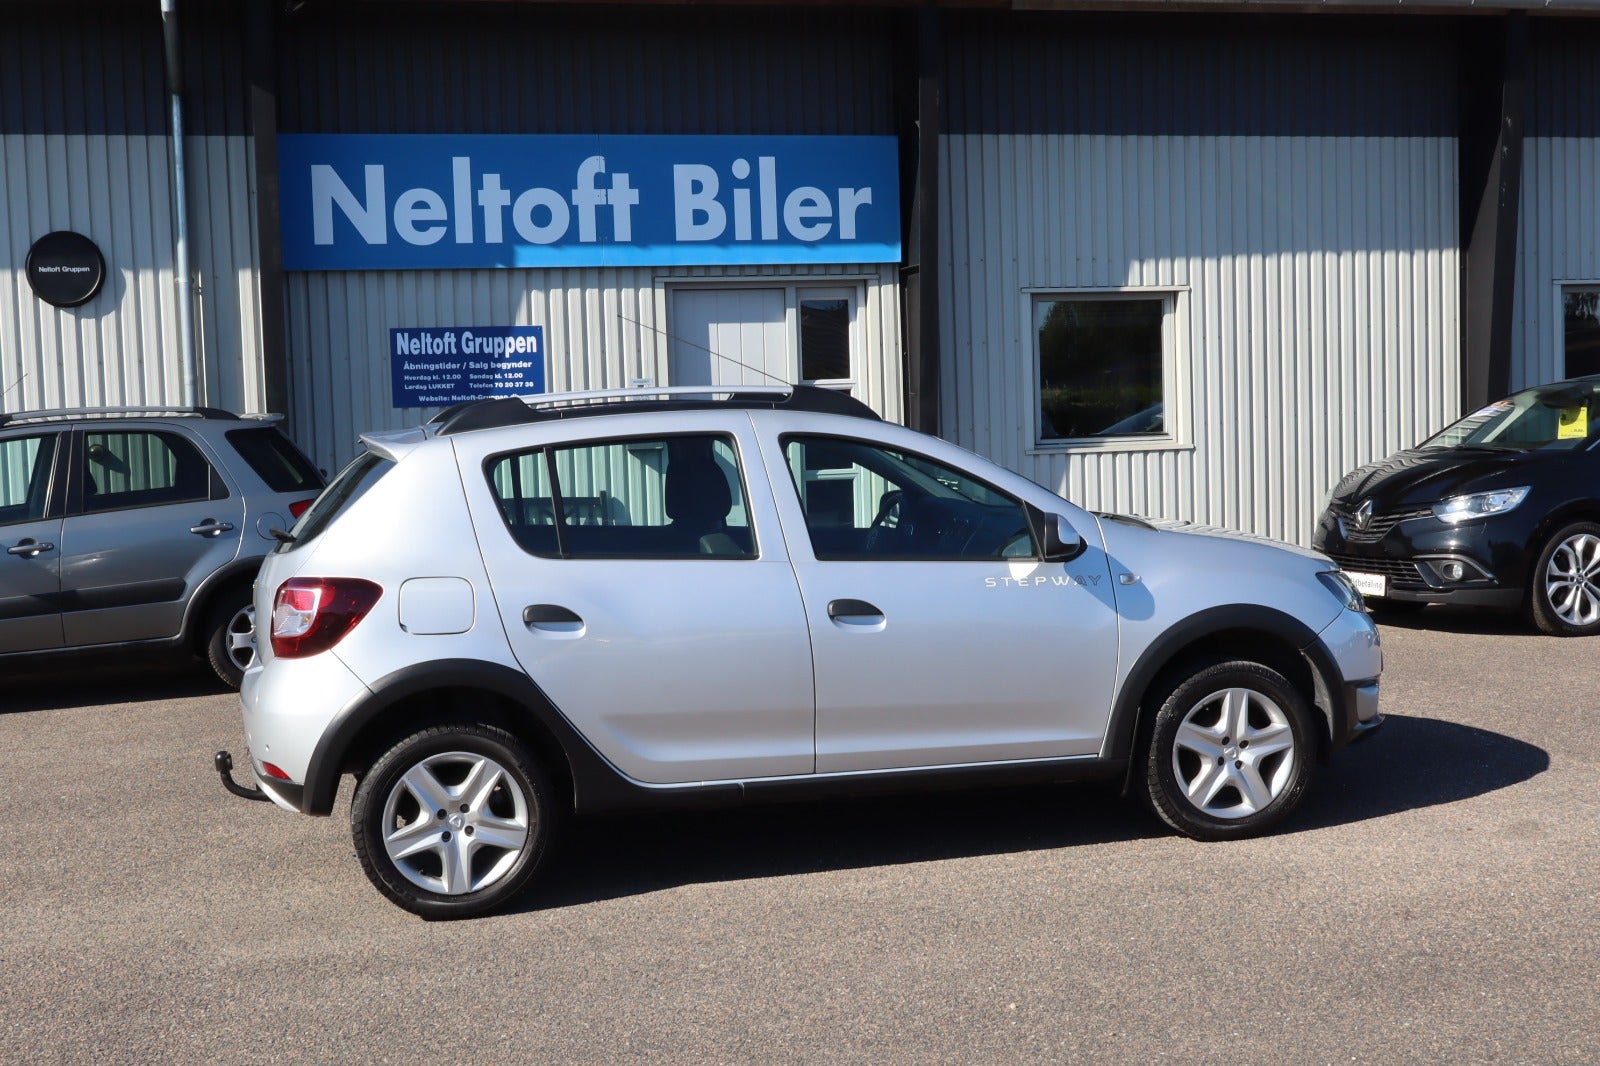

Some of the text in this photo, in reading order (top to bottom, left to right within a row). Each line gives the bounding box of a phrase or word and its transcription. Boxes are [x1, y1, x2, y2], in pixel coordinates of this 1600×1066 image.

[310, 155, 872, 246] Neltoft Biler
[396, 331, 537, 358] Neltoft Gruppen
[403, 361, 533, 371] Åbningstider / Salg begynder
[984, 574, 1101, 588] STEPWAY
